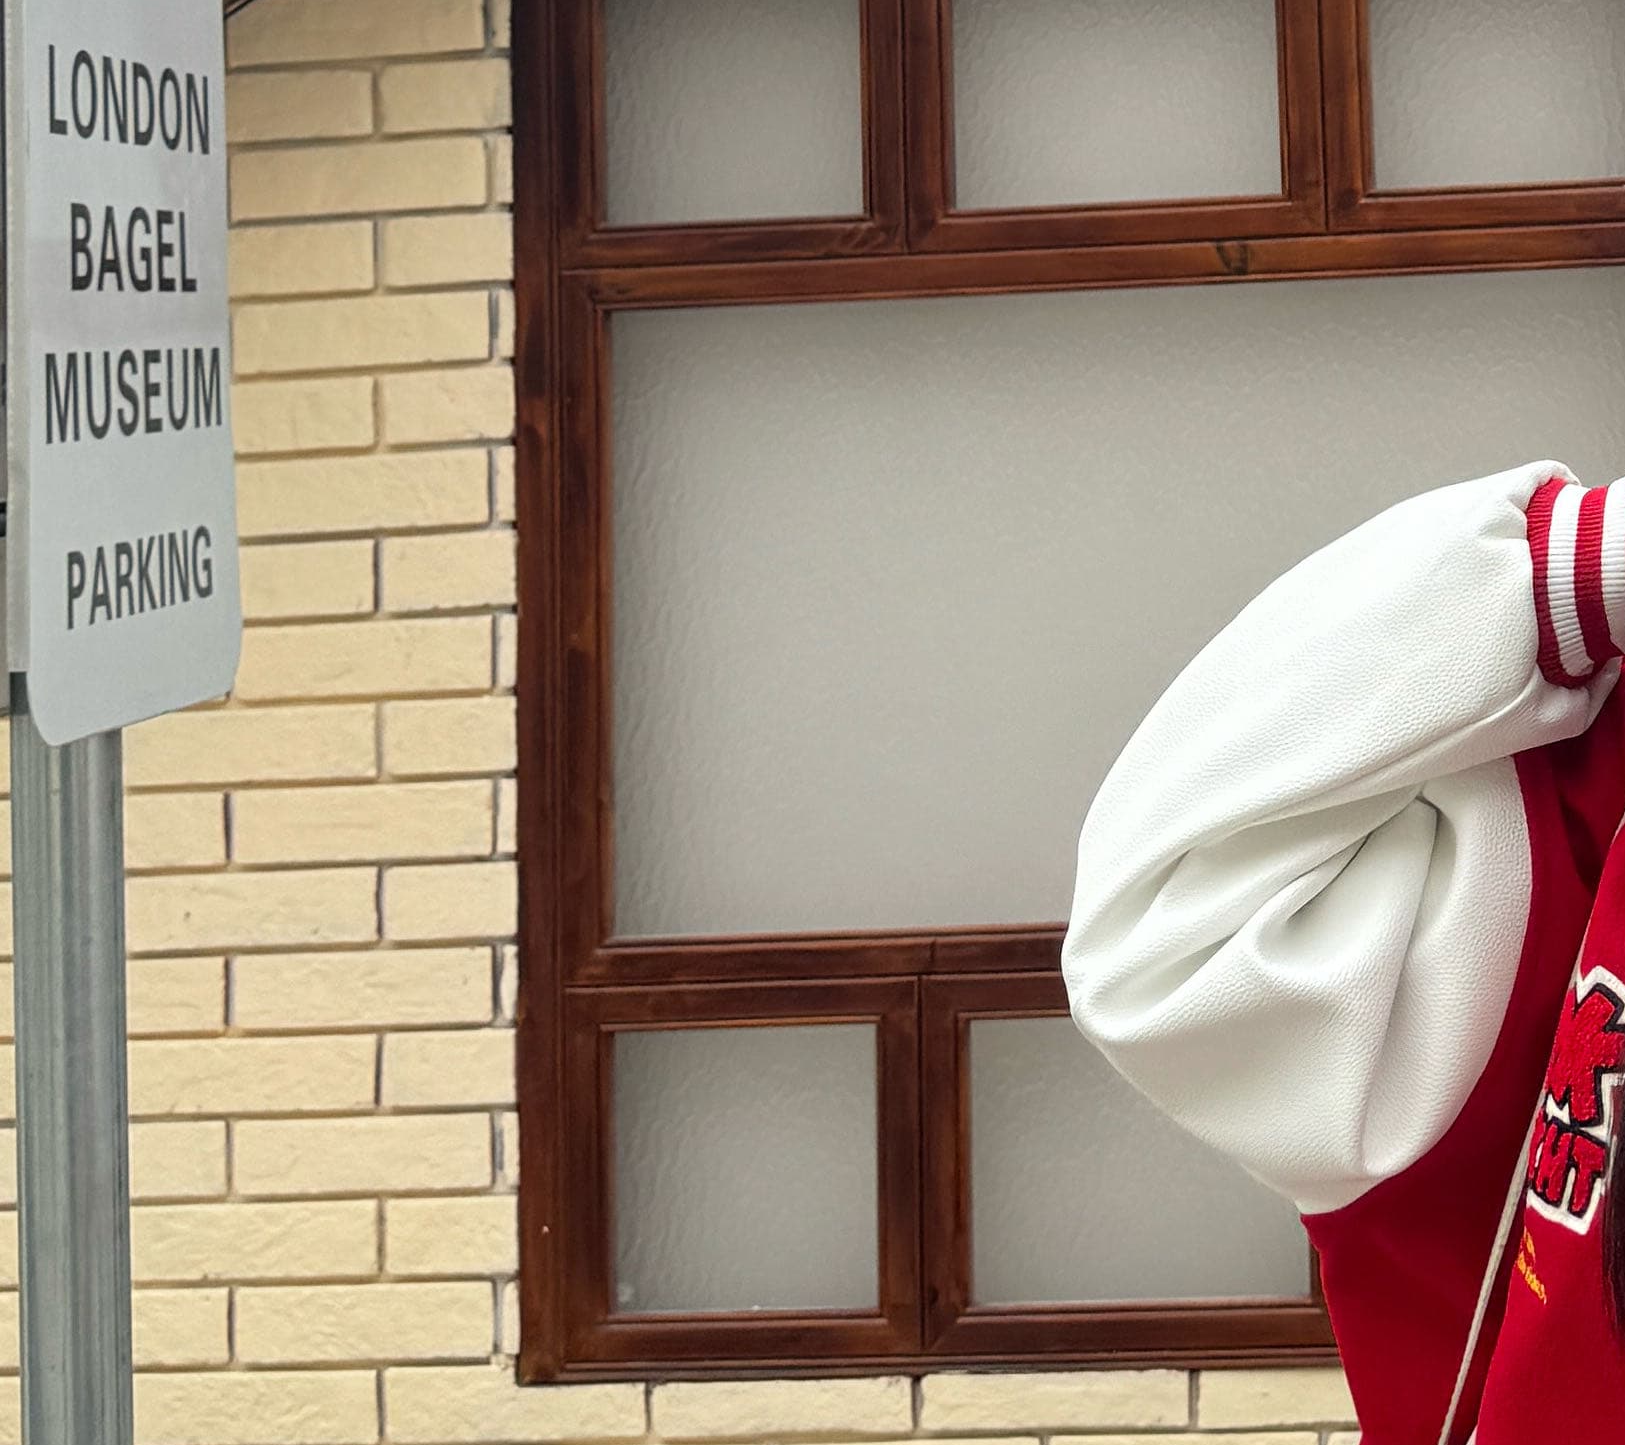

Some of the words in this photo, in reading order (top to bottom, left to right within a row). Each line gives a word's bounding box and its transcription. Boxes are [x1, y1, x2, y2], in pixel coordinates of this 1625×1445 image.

[47, 44, 211, 155] LONDON
[69, 202, 198, 293] BAGEL
[45, 347, 223, 444] MUSEUM
[66, 526, 214, 630] PARKING
